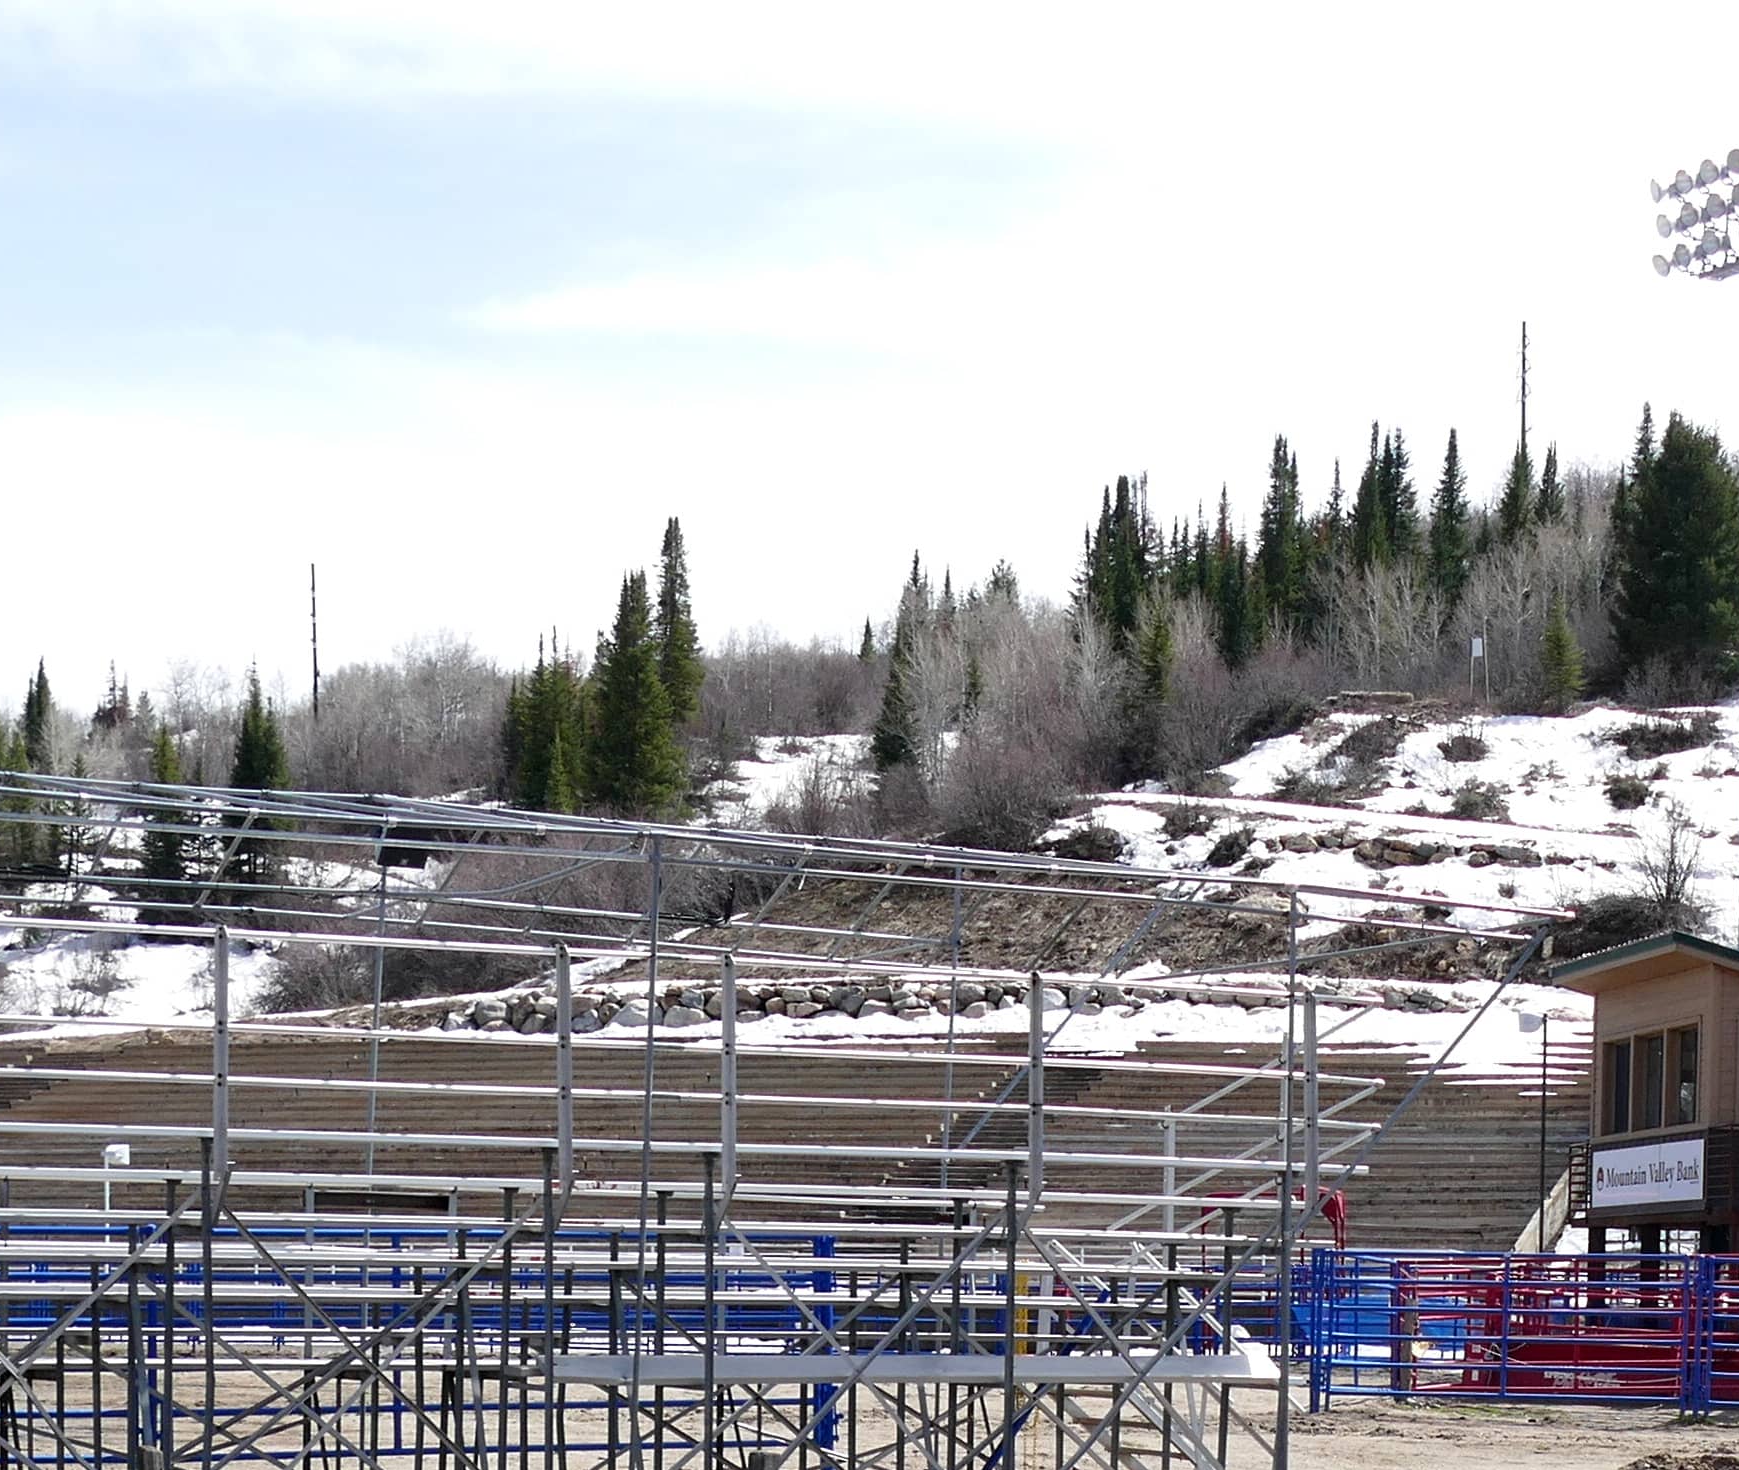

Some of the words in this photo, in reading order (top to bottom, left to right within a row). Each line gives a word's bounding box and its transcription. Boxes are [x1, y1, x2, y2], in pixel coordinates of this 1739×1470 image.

[1605, 1165, 1646, 1188] Mountain
[1649, 1161, 1675, 1189] Valley
[1677, 1158, 1700, 1182] Bank
